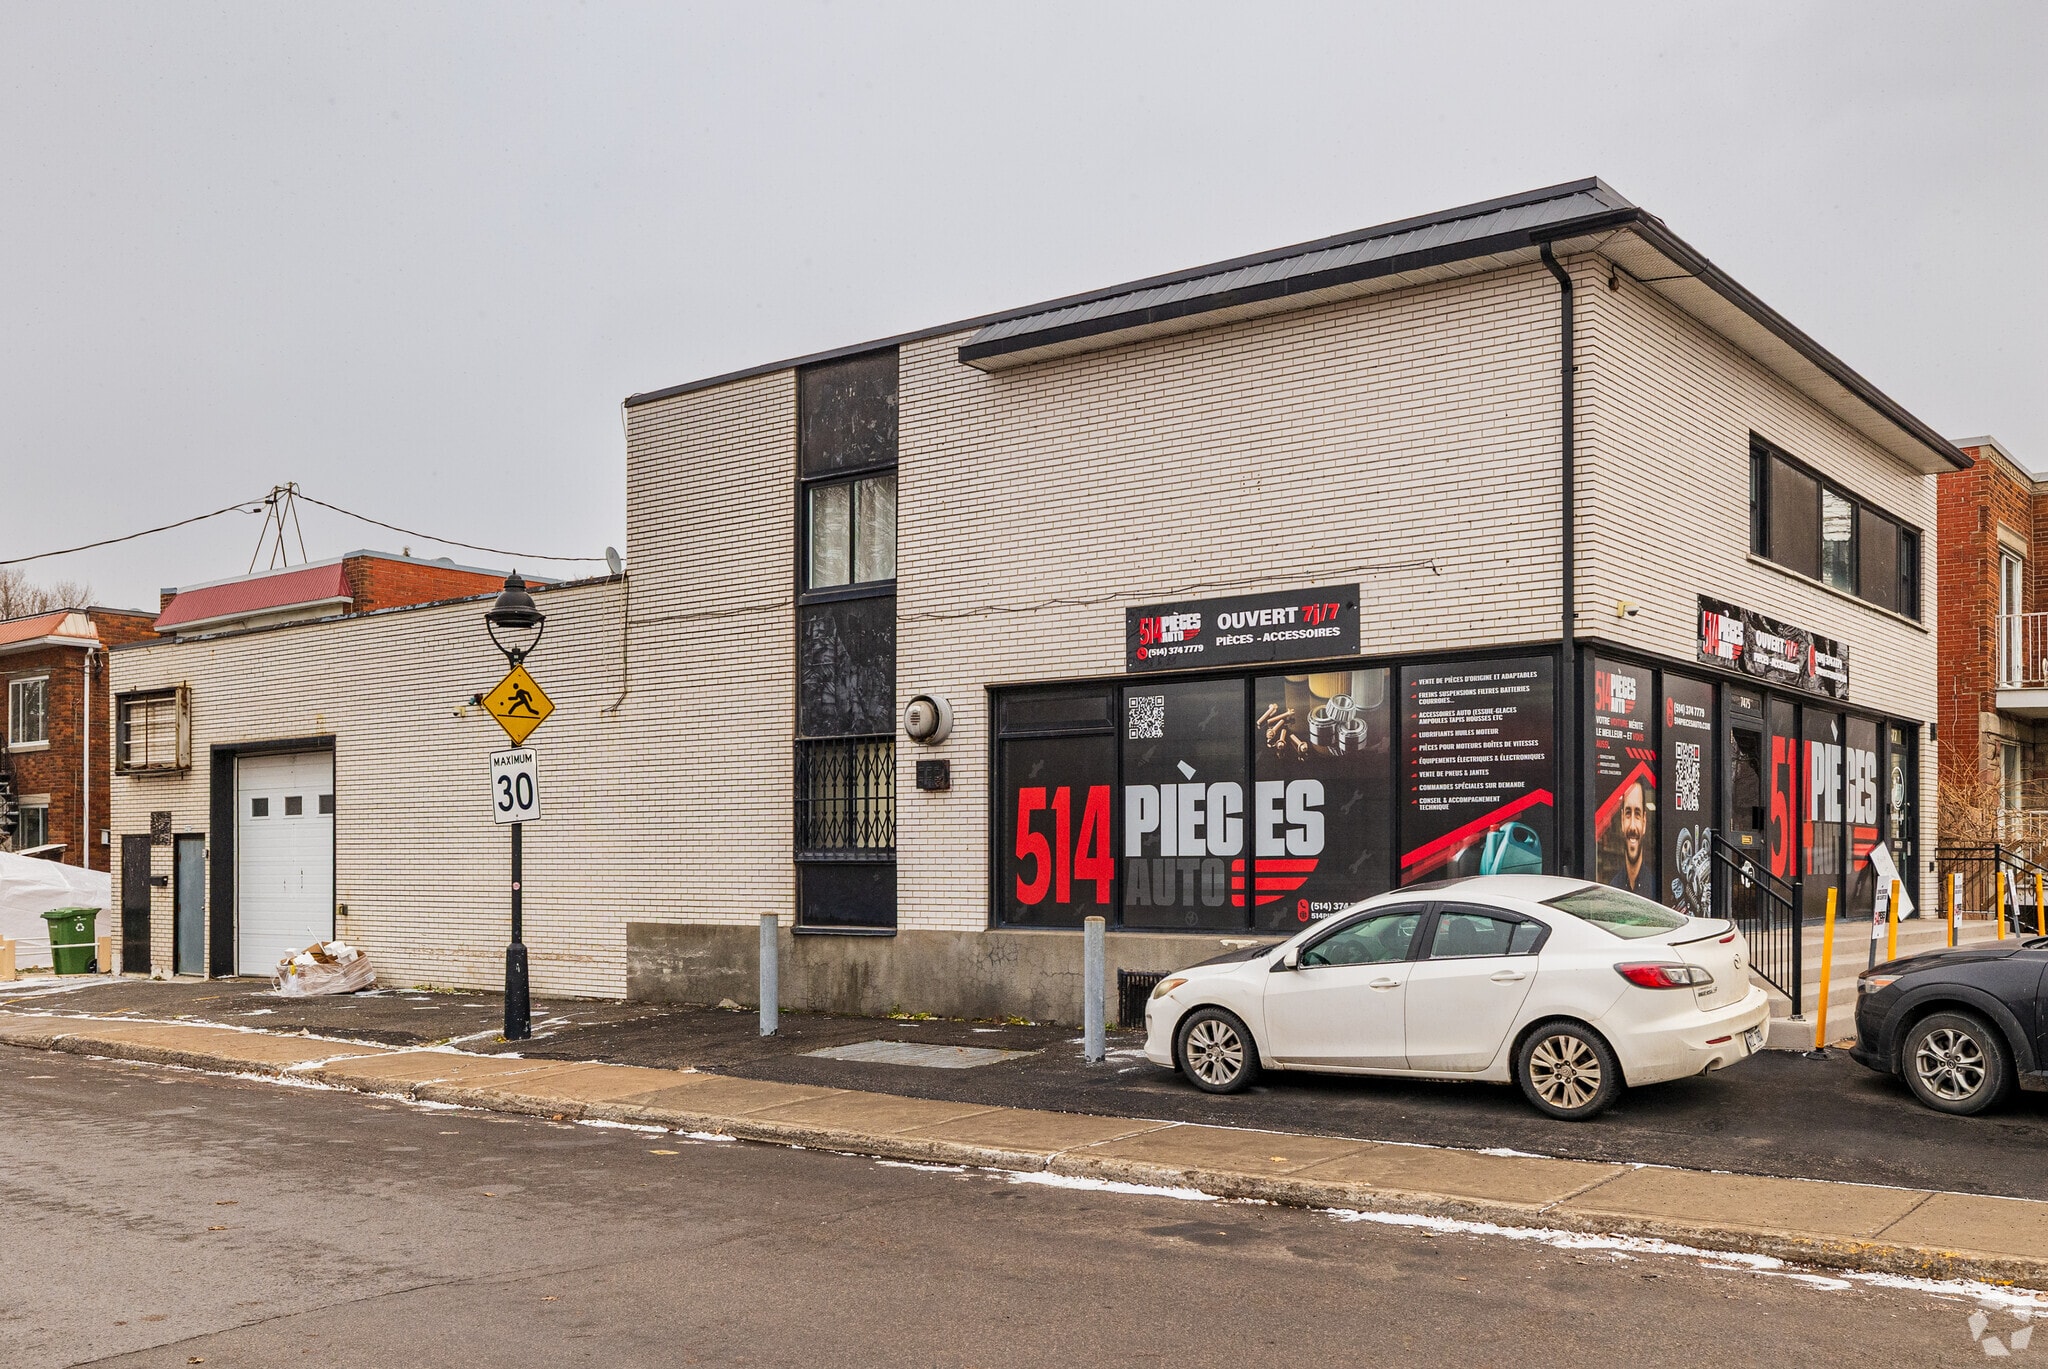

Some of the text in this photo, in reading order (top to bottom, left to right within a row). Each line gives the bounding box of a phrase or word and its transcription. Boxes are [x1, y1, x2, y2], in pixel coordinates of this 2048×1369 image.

[1217, 606, 1299, 630] OUVERT
[1139, 612, 1201, 645] 514 PIÈCES
[1703, 610, 1719, 656] 514
[1161, 631, 1184, 643] AUTO
[1216, 634, 1254, 646] PIÈCES
[1755, 630, 1785, 655] OUVERT
[1148, 644, 1204, 658] (514) 374 7779
[1419, 678, 1435, 686] VENTE
[1444, 675, 1463, 684] PIÈCES
[1465, 673, 1492, 682] D'ORIGINE
[1501, 671, 1537, 680] ADAPTABLES
[1418, 685, 1530, 699] FREINS SUSPENSIONS FILTRES BATTERIES
[1595, 668, 1637, 712] 514 PIÈCES
[1418, 710, 1456, 719] ACCESSOIRES
[1674, 702, 1705, 718] (514) 374 7779
[1418, 716, 1448, 725] AMPOULES
[1449, 715, 1465, 723] TAPIS
[1465, 714, 1491, 722] HOUSSES
[1595, 715, 1610, 726] VOTRE
[1628, 719, 1644, 730] MÉRITE
[1419, 727, 1499, 739] LUBRIFIANTS HUILES MOTEUR
[1595, 728, 1602, 736] LE
[1602, 729, 1623, 740] MEILLEUR
[1627, 731, 1632, 740] ET
[1419, 742, 1438, 751] PIÈCES
[1455, 741, 1482, 750] MOTEURS
[1483, 739, 1503, 748] BOÎTES
[1512, 739, 1539, 747] VITESSES
[493, 753, 532, 767] MAXIMUM
[1419, 755, 1456, 765] ÉQUIPEMENTS
[1457, 754, 1493, 763] ÉLECTRIQUES
[1499, 752, 1545, 762] ÉLECTRONIQUES
[497, 772, 533, 812] 30
[1419, 783, 1453, 791] COMMANDES
[1454, 782, 1484, 790] SPÉCIALES
[1498, 781, 1525, 789] DEMANDE
[1448, 796, 1500, 804] ACCOMPAGNEMENT
[1770, 719, 1877, 879] 514 PIÈCES
[1015, 760, 1325, 905] 514 PIÈCES
[1126, 858, 1225, 908] AUTO
[1310, 901, 1332, 912] (514)
